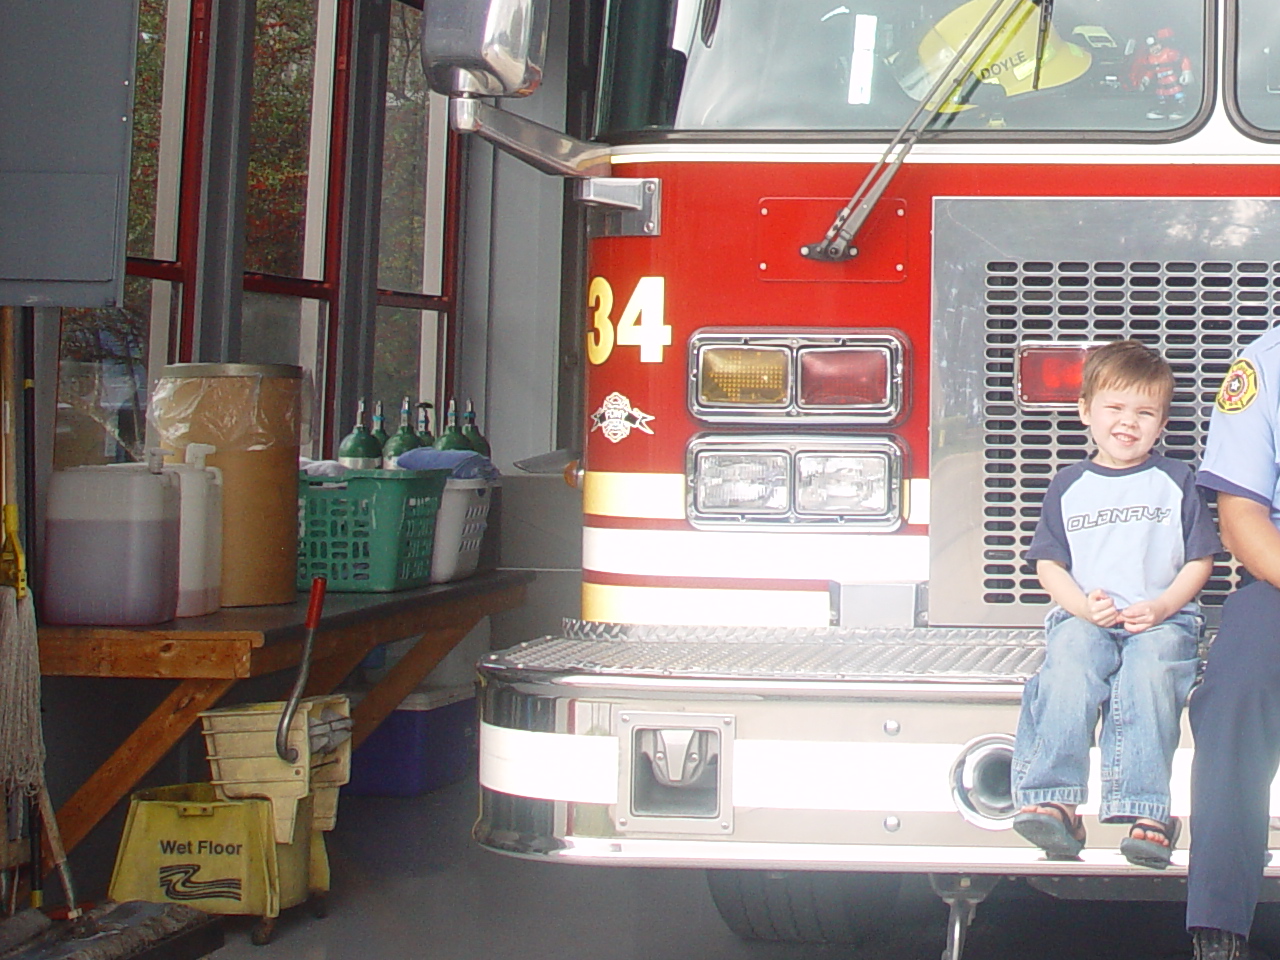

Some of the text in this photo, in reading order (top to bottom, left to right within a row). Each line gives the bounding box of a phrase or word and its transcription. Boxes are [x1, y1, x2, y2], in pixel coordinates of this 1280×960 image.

[980, 50, 1027, 79] DOYLE
[587, 275, 672, 365] 34
[160, 840, 243, 855] Wet Floor
